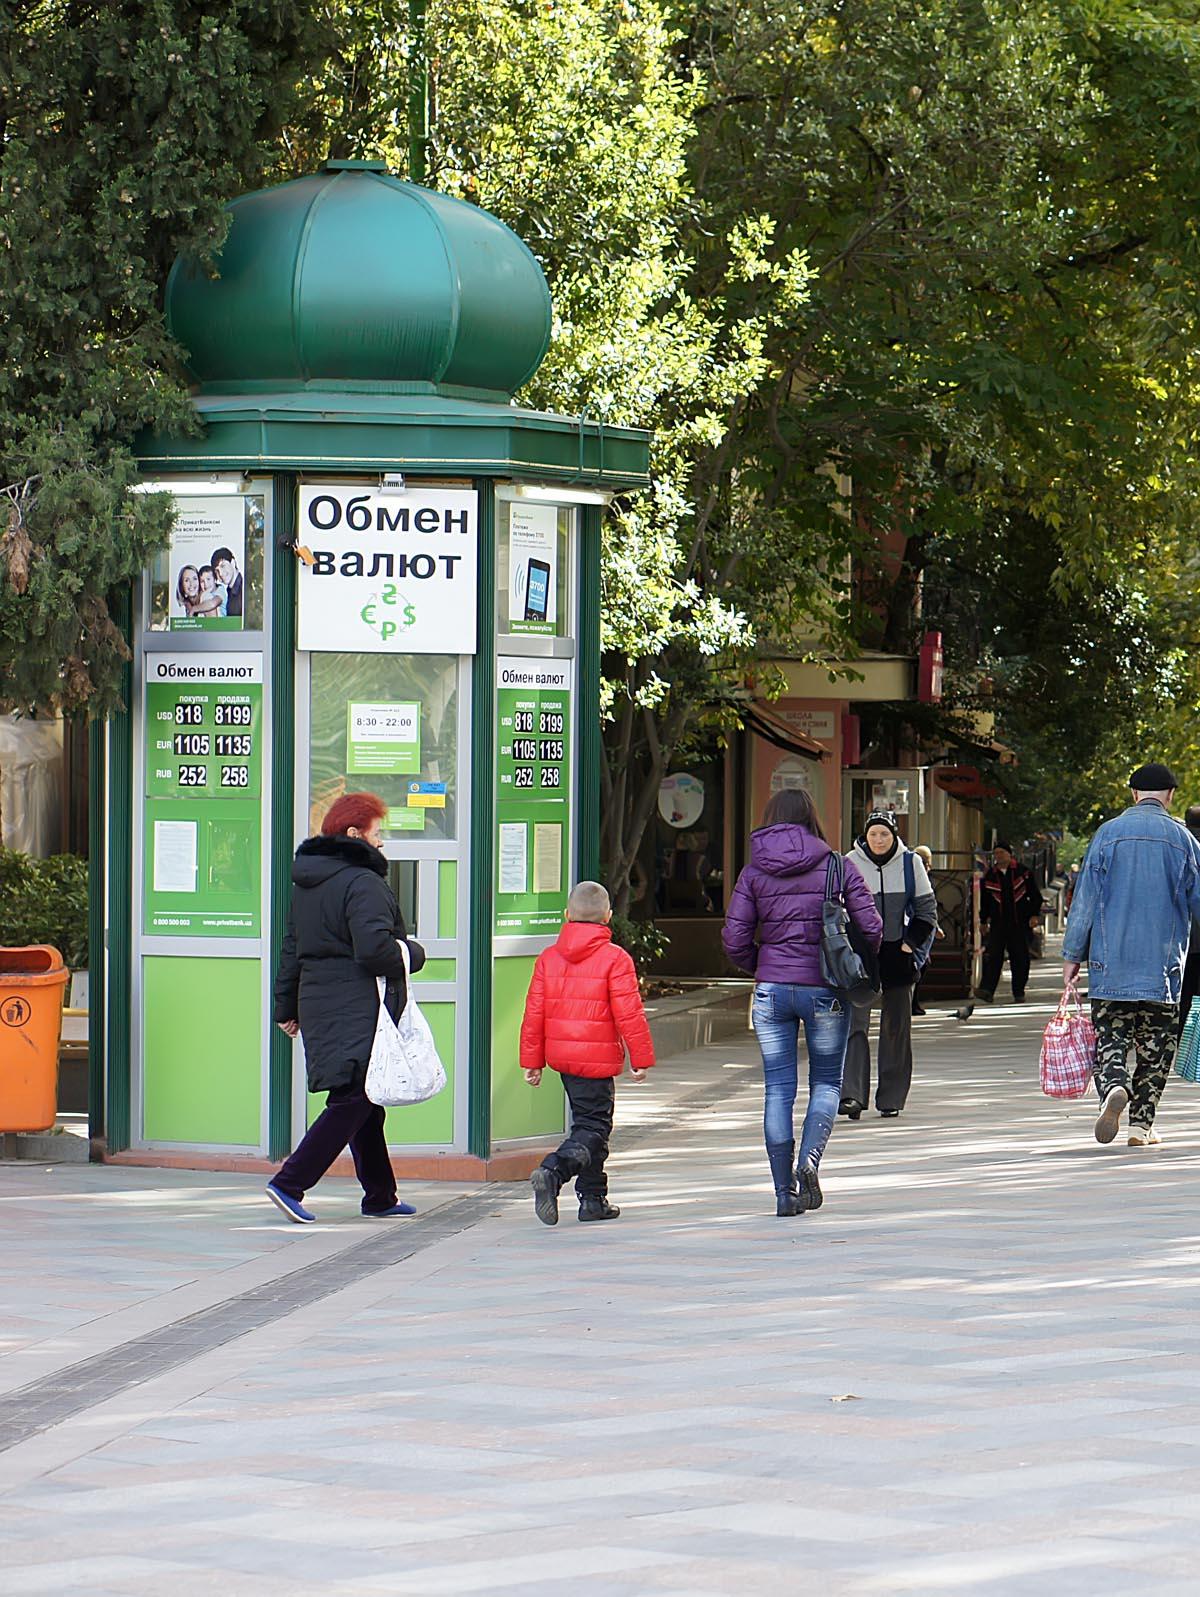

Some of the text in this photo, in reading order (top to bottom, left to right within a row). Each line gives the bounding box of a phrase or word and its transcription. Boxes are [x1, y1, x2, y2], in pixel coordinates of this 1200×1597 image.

[308, 495, 468, 533] Обмен
[312, 551, 461, 579] валют
[157, 663, 253, 677] Обмен валют
[502, 669, 564, 684] Обмен валют
[179, 695, 250, 704] покупка продажа
[157, 705, 251, 724] USD 818 8199
[356, 717, 377, 726] 8:30
[386, 718, 412, 727] 22:00
[515, 712, 533, 731] 818
[539, 713, 563, 732] 8199
[156, 735, 251, 755] EUR 1105 1135
[513, 740, 536, 759] 1105
[540, 741, 563, 759] 1135
[156, 766, 248, 786] RUB 252 258
[515, 768, 533, 786] 252
[541, 768, 559, 786] 258
